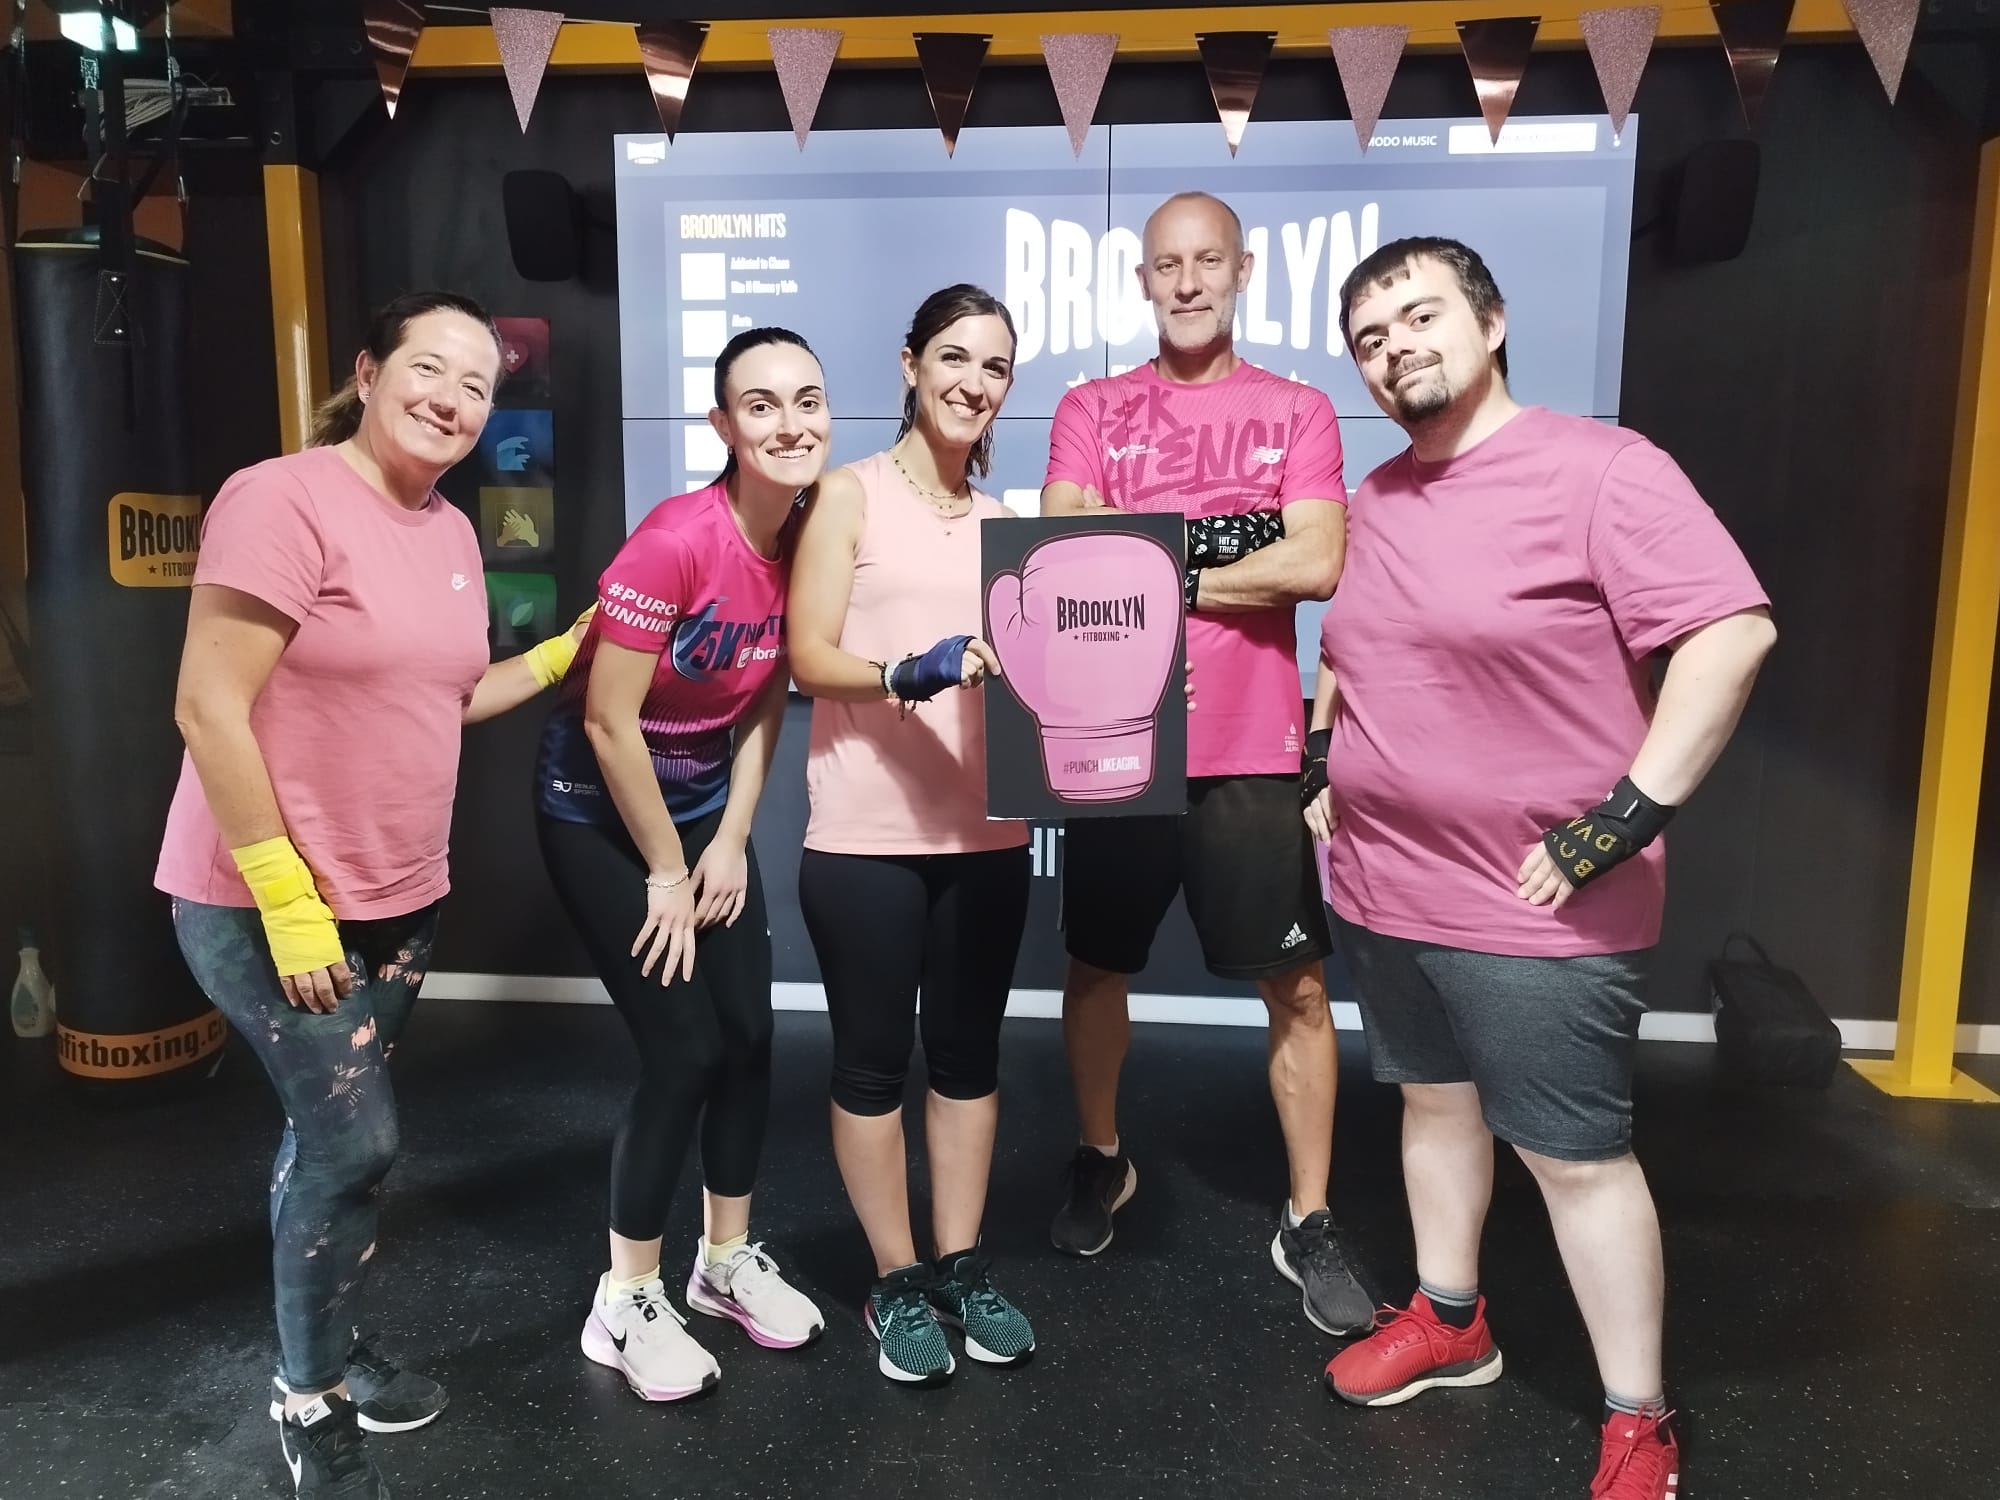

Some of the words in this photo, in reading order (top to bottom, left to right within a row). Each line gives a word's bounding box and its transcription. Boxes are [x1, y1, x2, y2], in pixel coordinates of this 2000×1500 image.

[1402, 135, 1438, 146] MUSIC
[680, 213, 752, 239] BROOKLYN
[754, 212, 787, 239] HITS
[1056, 593, 1145, 633] BROOKLYN
[1082, 631, 1120, 642] FITBOXING
[1063, 755, 1141, 775] #PUNCHLIKEAGIRL
